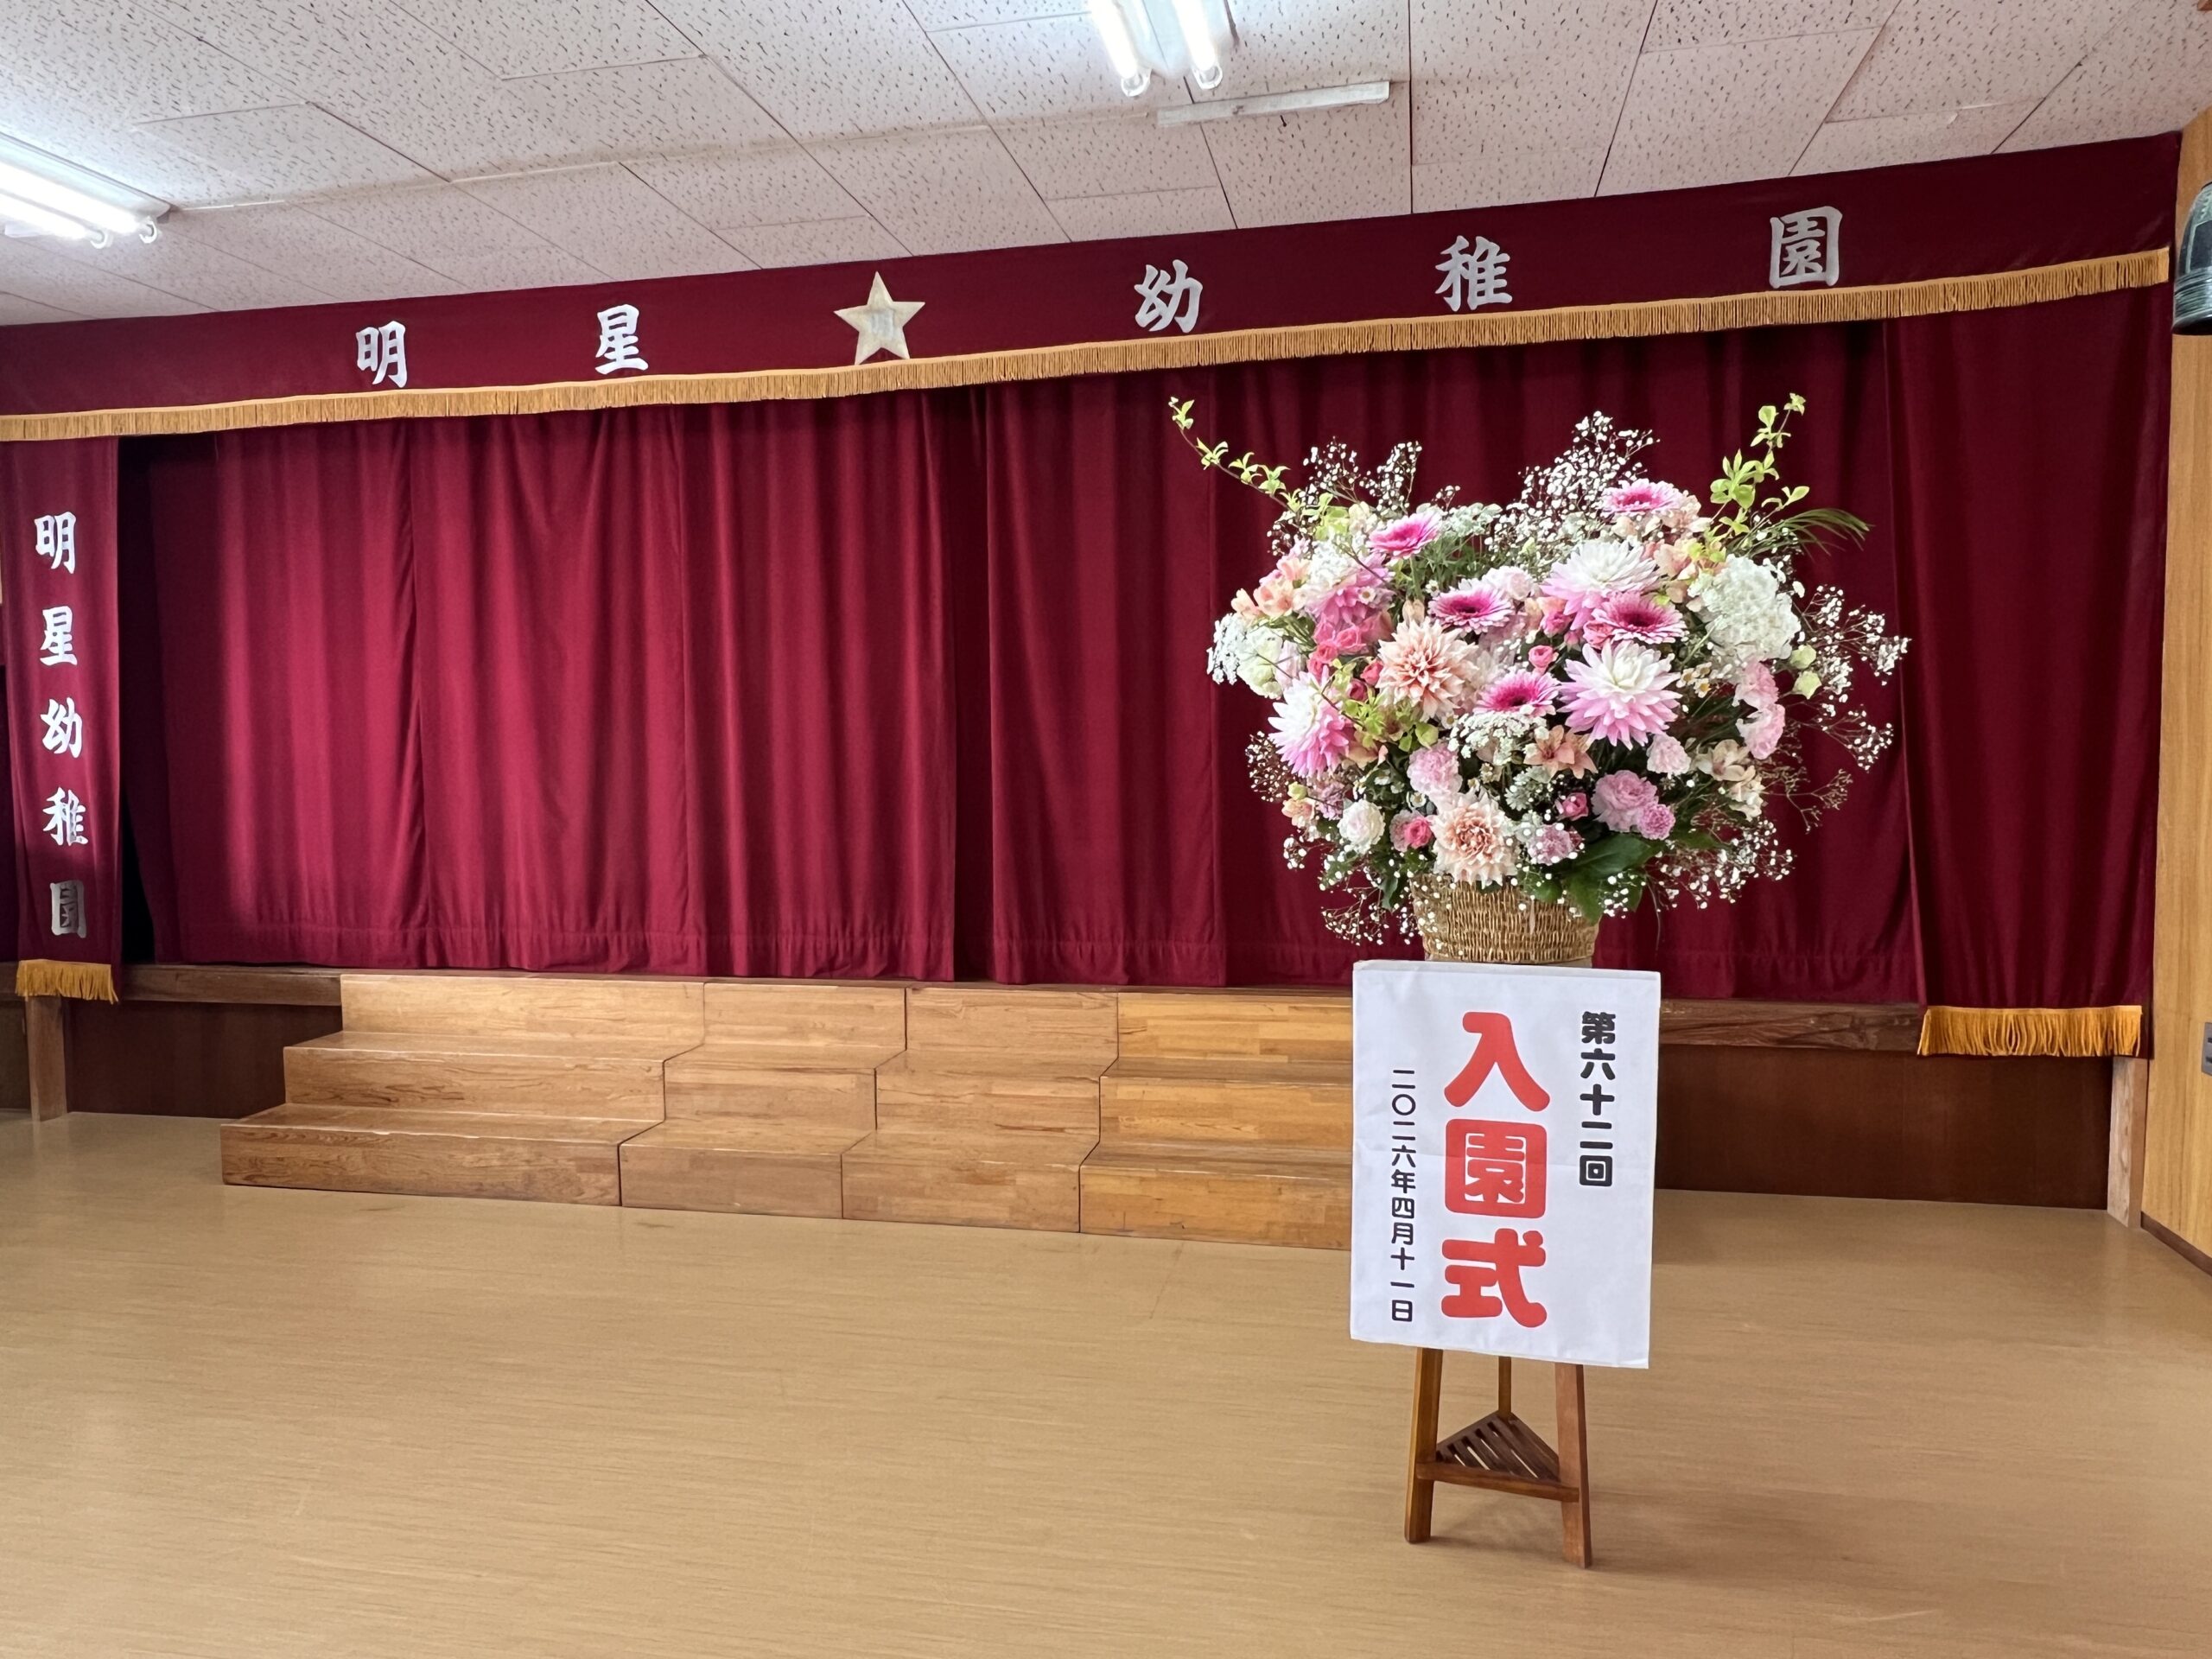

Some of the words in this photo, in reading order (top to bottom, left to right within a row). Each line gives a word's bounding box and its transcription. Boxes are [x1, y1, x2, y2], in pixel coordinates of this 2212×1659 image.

[34, 512, 89, 938] 明星幼稚園
[1390, 1069, 1417, 1323] 二〇二六年四月十一日
[1440, 1011, 1551, 1329] 入園式
[1579, 1011, 1617, 1187] 第六十二回
